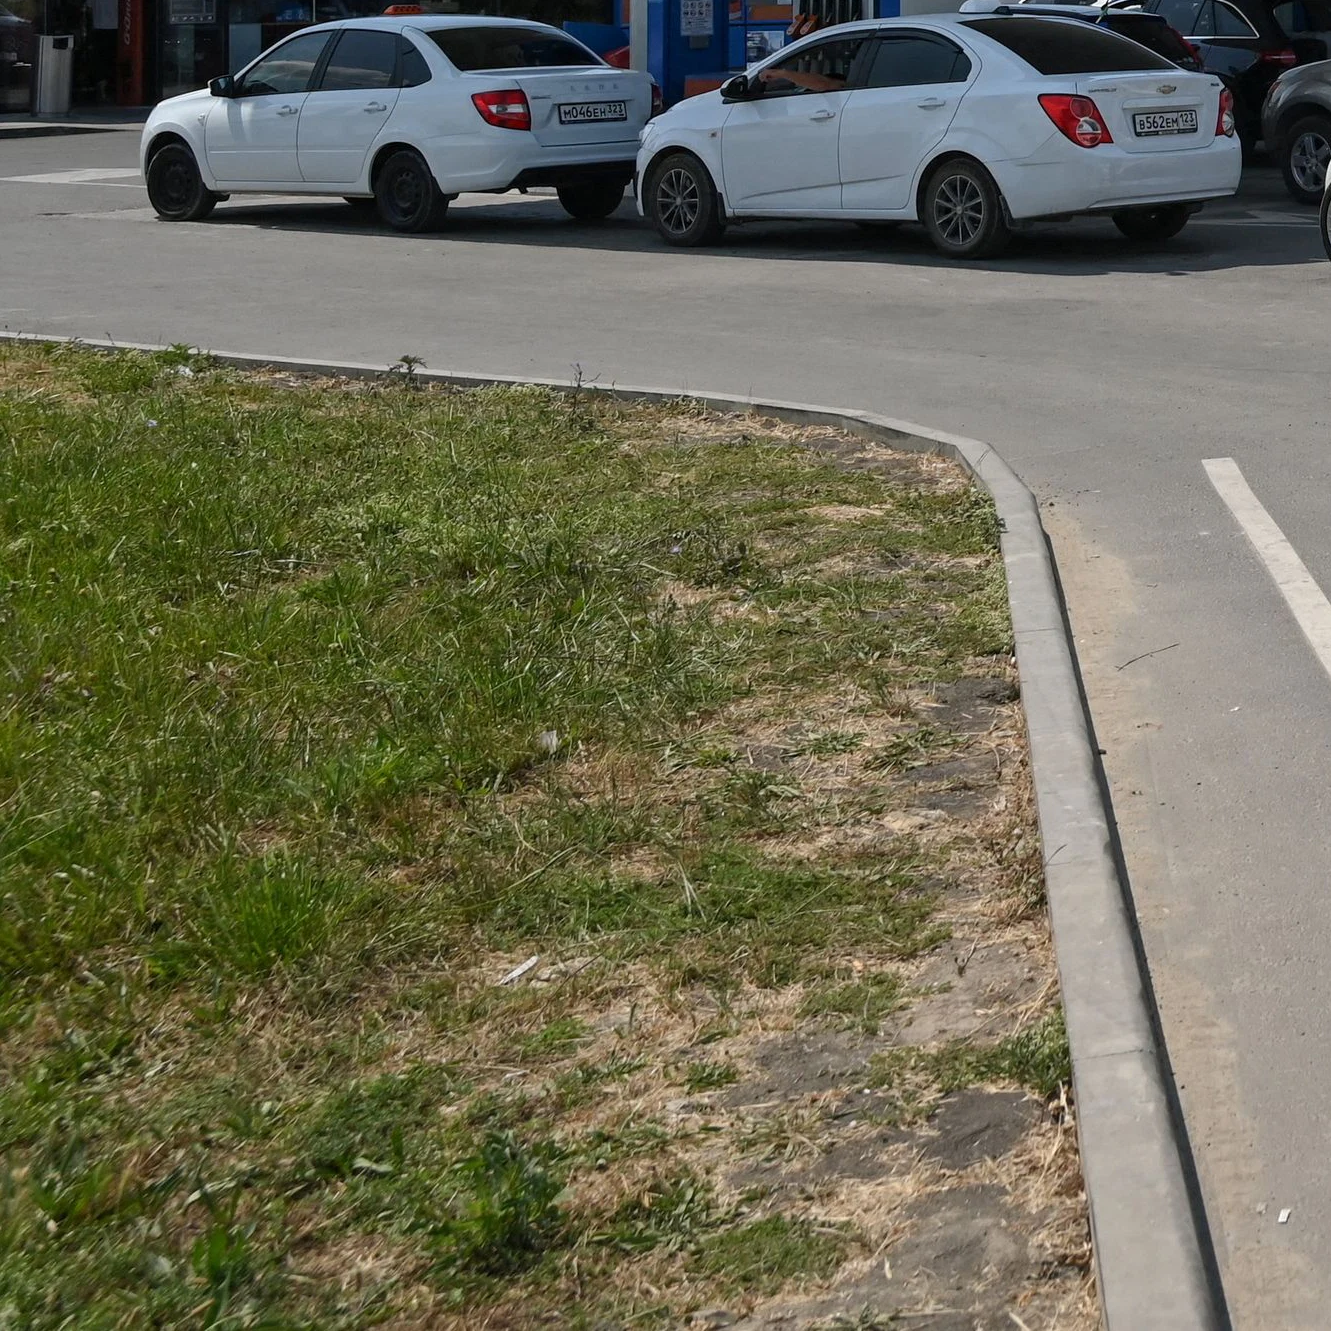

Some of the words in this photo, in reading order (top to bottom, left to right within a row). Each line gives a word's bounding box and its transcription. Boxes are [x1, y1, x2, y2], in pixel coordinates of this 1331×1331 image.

[607, 104, 623, 114] 323
[1139, 115, 1178, 130] В562ЕМ
[1180, 112, 1194, 124] 123
